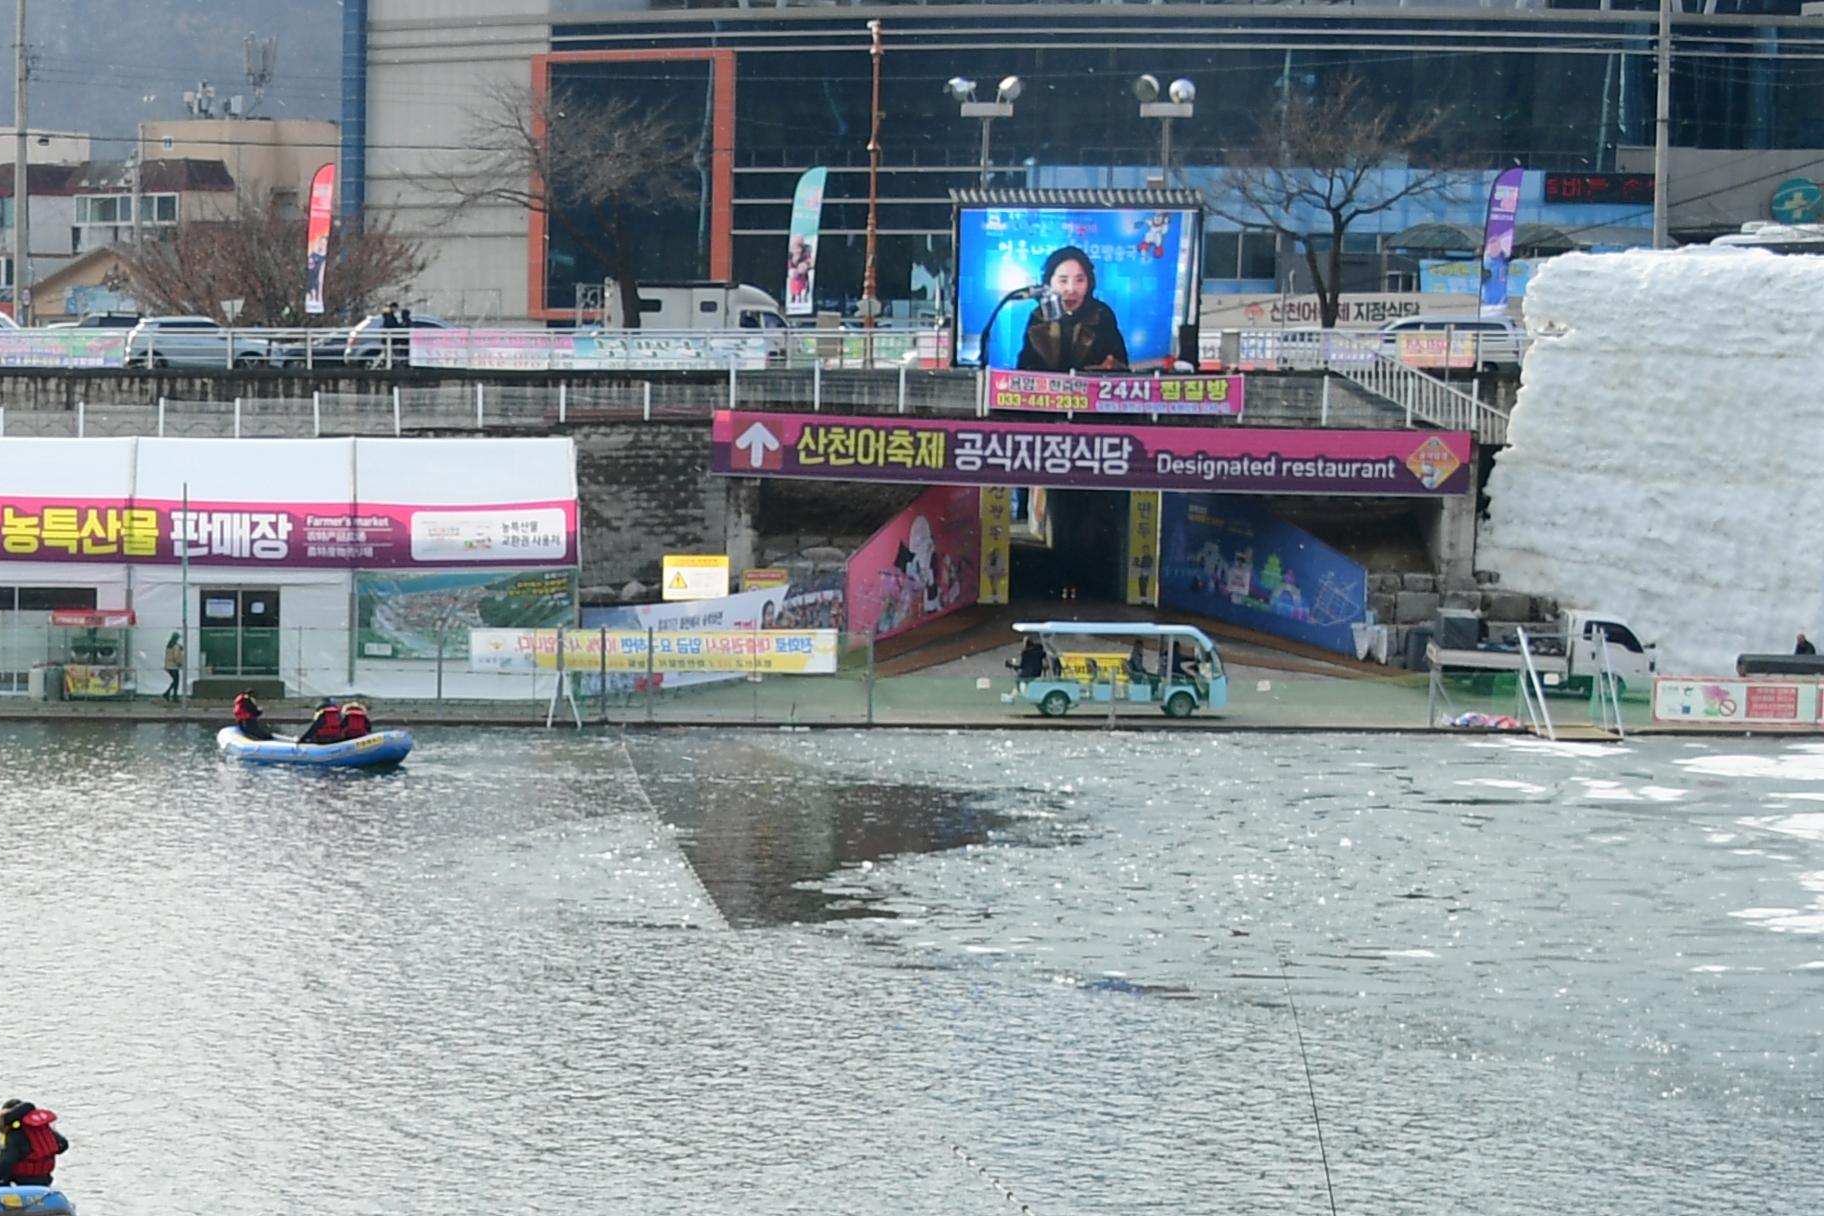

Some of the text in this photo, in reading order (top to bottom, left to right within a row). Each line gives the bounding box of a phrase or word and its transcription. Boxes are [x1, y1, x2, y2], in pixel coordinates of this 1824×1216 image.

[1270, 301, 1350, 322] 산천어제
[997, 392, 1088, 409] 033-441-2333
[1098, 379, 1229, 401] 24시 찜질방
[796, 426, 1133, 475] 산천어축제 공식지정식당
[1157, 452, 1395, 480] Designated restaurant
[306, 515, 390, 528] Farmer's market
[1, 506, 293, 560] 농특산물 판매장
